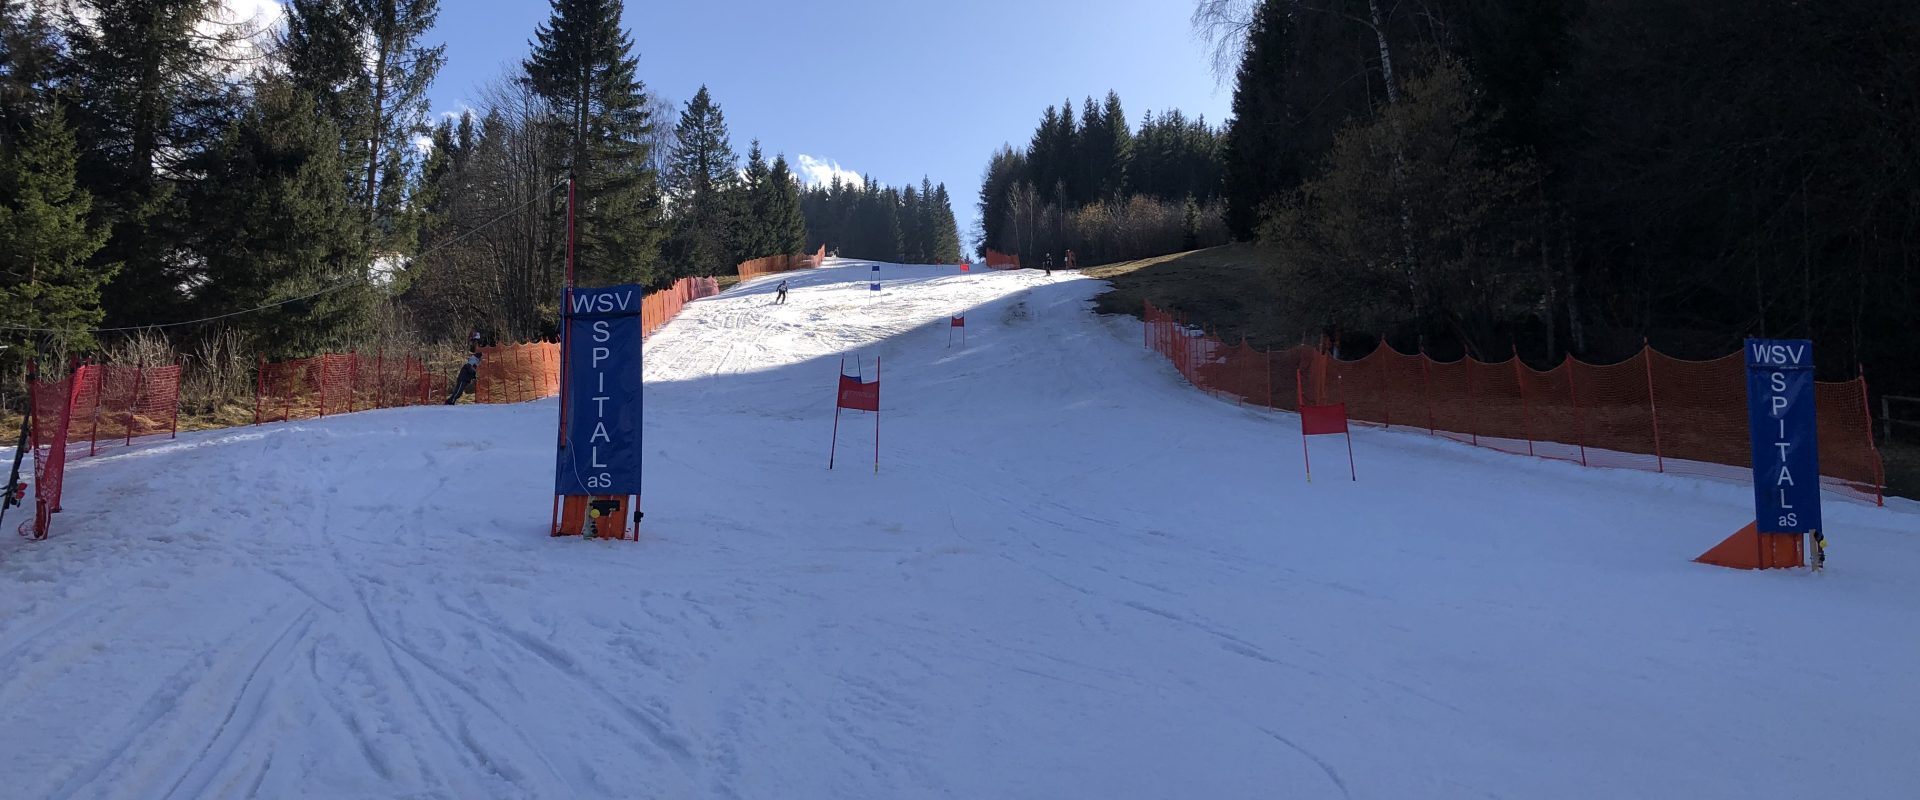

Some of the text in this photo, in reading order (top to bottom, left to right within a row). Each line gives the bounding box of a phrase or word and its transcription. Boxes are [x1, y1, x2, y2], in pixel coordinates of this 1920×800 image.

[572, 290, 632, 313] WSV
[1752, 343, 1804, 364] WSV
[590, 321, 611, 468] SPITAL
[1771, 372, 1794, 509] SPITAL
[587, 473, 612, 488] aS
[1778, 513, 1798, 528] aS
